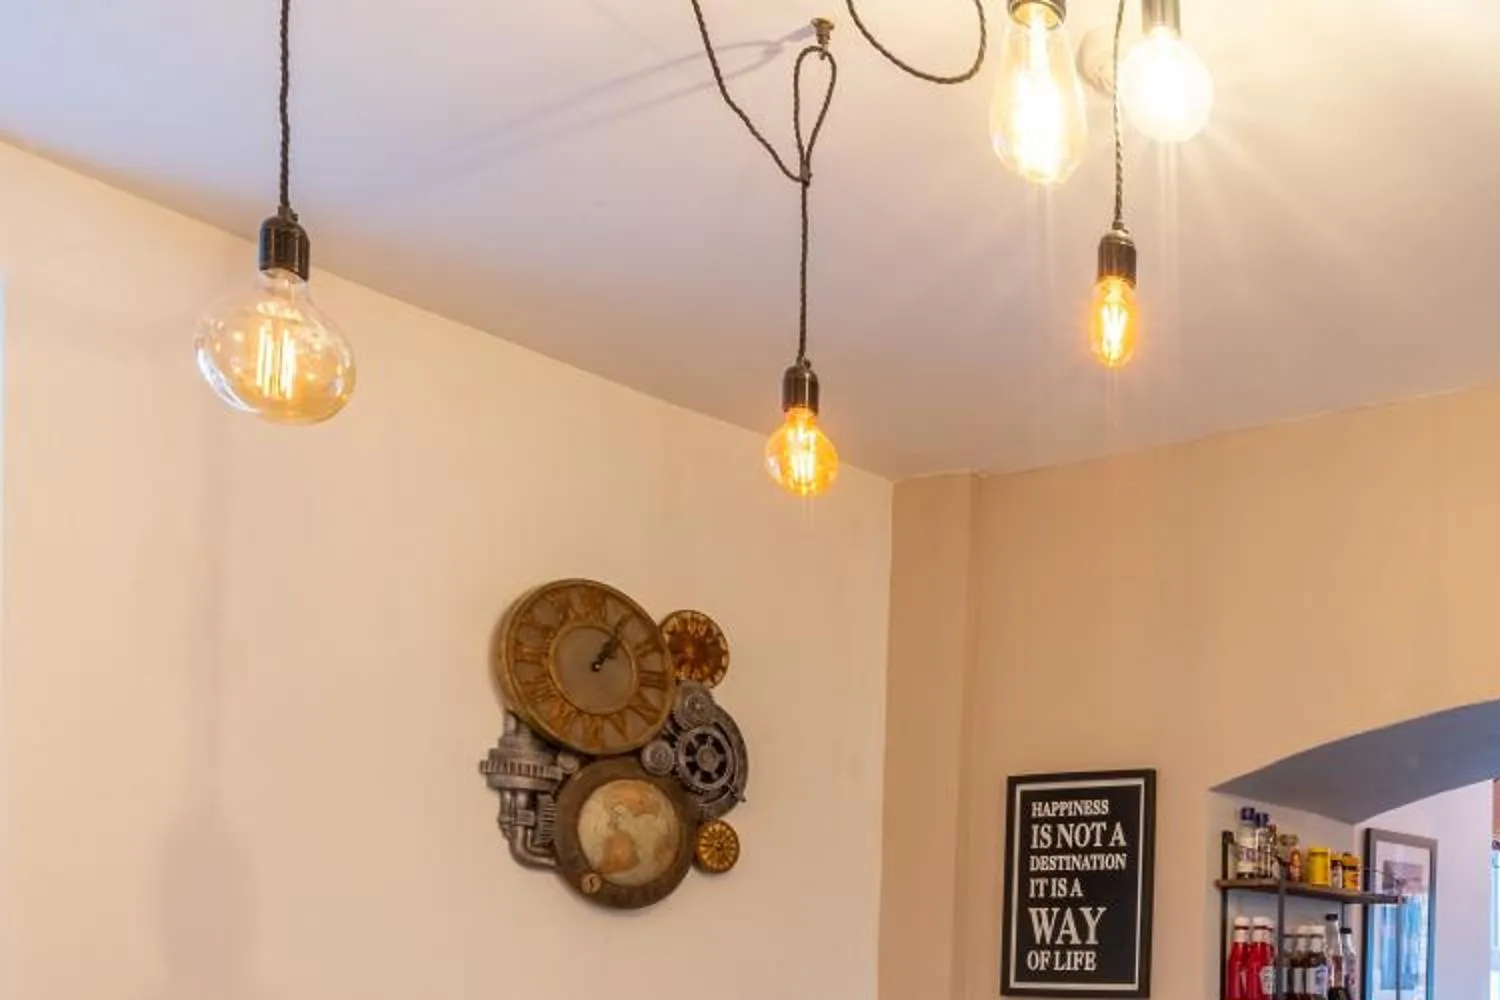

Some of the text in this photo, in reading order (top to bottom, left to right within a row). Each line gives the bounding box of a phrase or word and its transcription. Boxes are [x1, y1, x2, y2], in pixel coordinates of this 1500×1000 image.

[1031, 799, 1109, 818] HAPPINESS
[1030, 821, 1127, 849] IS NOT A
[1029, 853, 1128, 872] DESTINATION
[1028, 877, 1084, 899] IT IS A
[1028, 906, 1107, 946] WAY
[1026, 950, 1097, 972] OF LIFE
